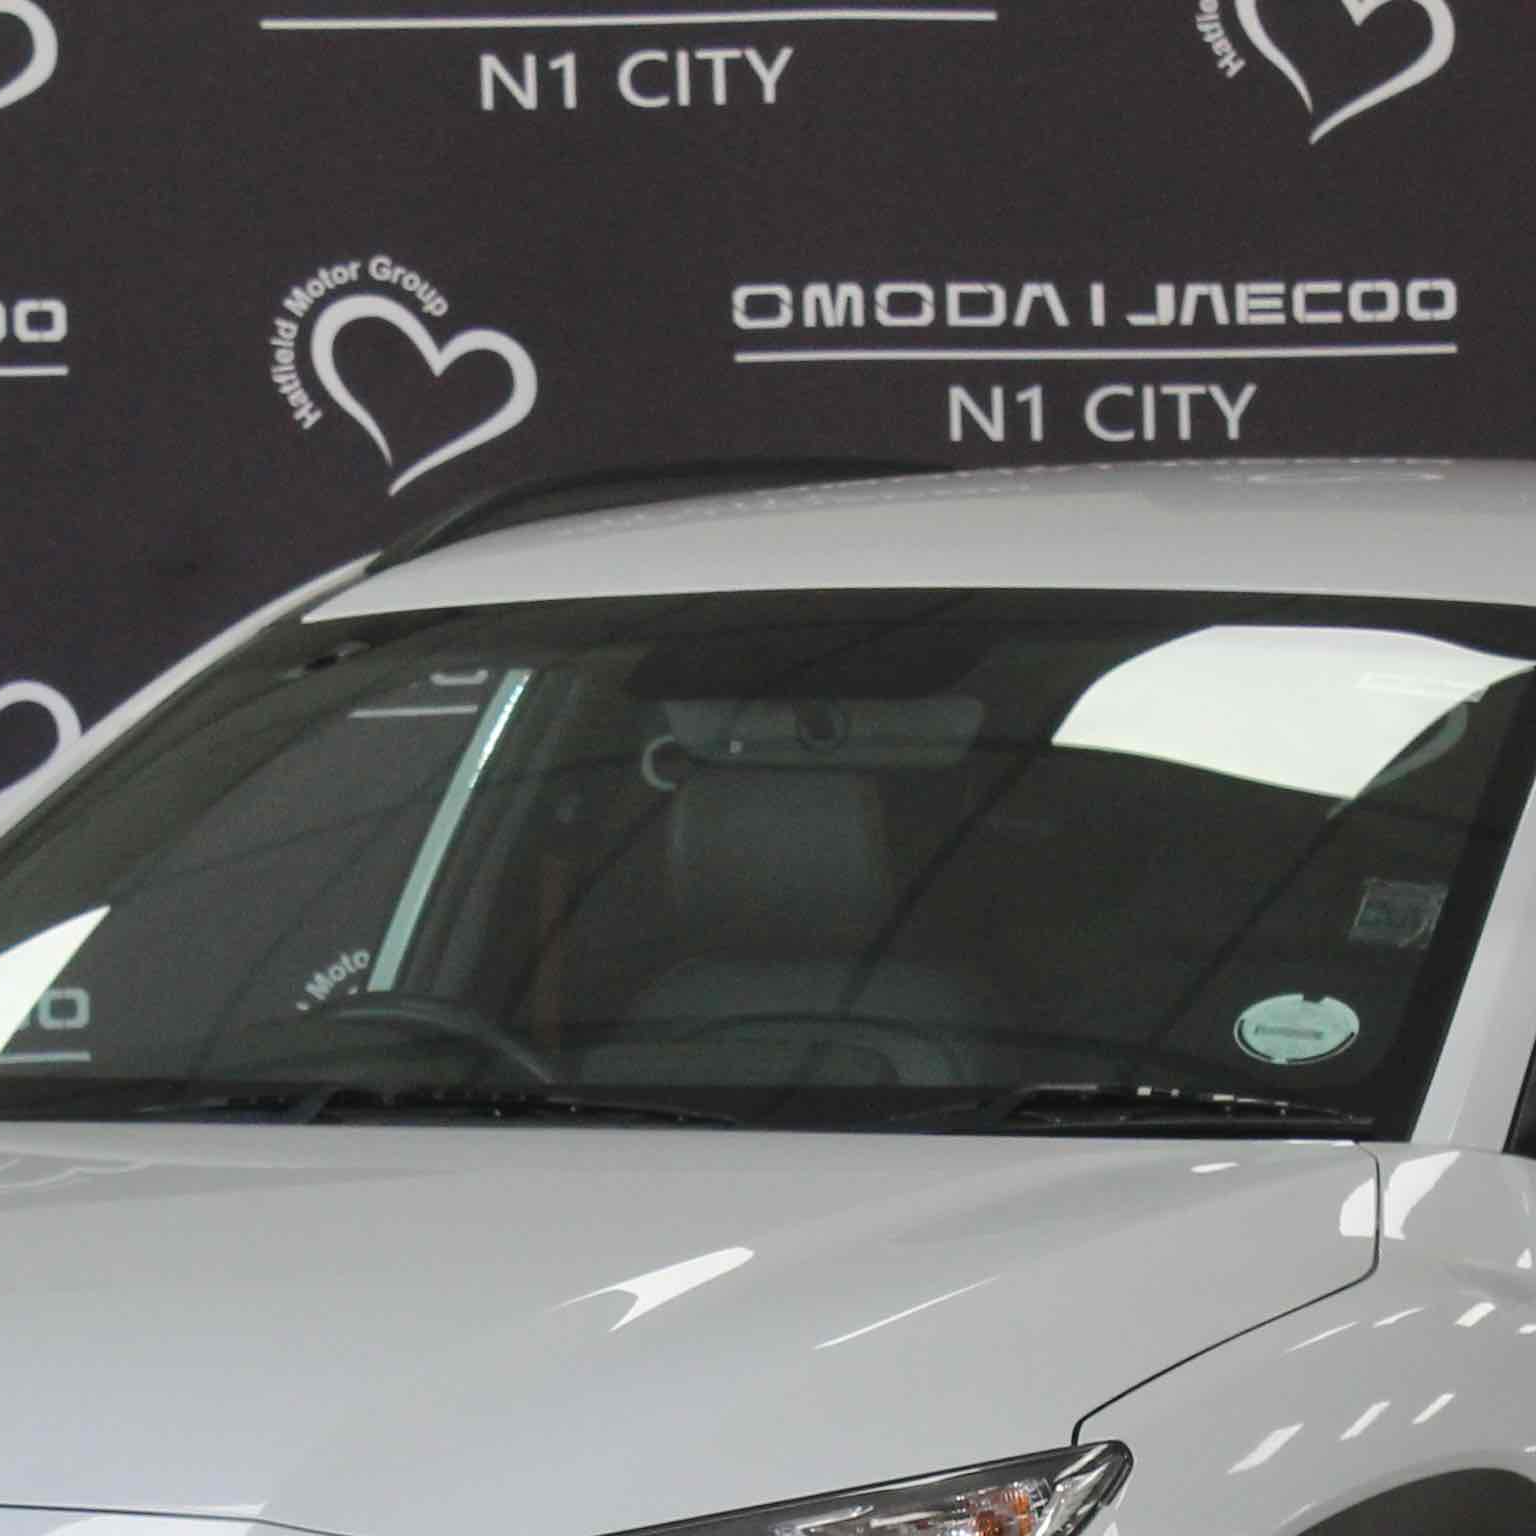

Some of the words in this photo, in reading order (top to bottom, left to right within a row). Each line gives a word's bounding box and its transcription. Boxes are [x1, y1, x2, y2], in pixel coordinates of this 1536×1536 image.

[1195, 0, 1247, 79] Hatfie
[480, 52, 577, 111] N1
[618, 47, 793, 108] CITY
[282, 260, 361, 318] Motor
[367, 254, 449, 317] Group
[732, 282, 1069, 330] OMODA
[1126, 278, 1457, 326] JAECOO
[269, 317, 323, 430] Hatfield
[949, 385, 1043, 442] N1
[1084, 384, 1257, 442] CITY
[305, 948, 371, 1002] Moto
